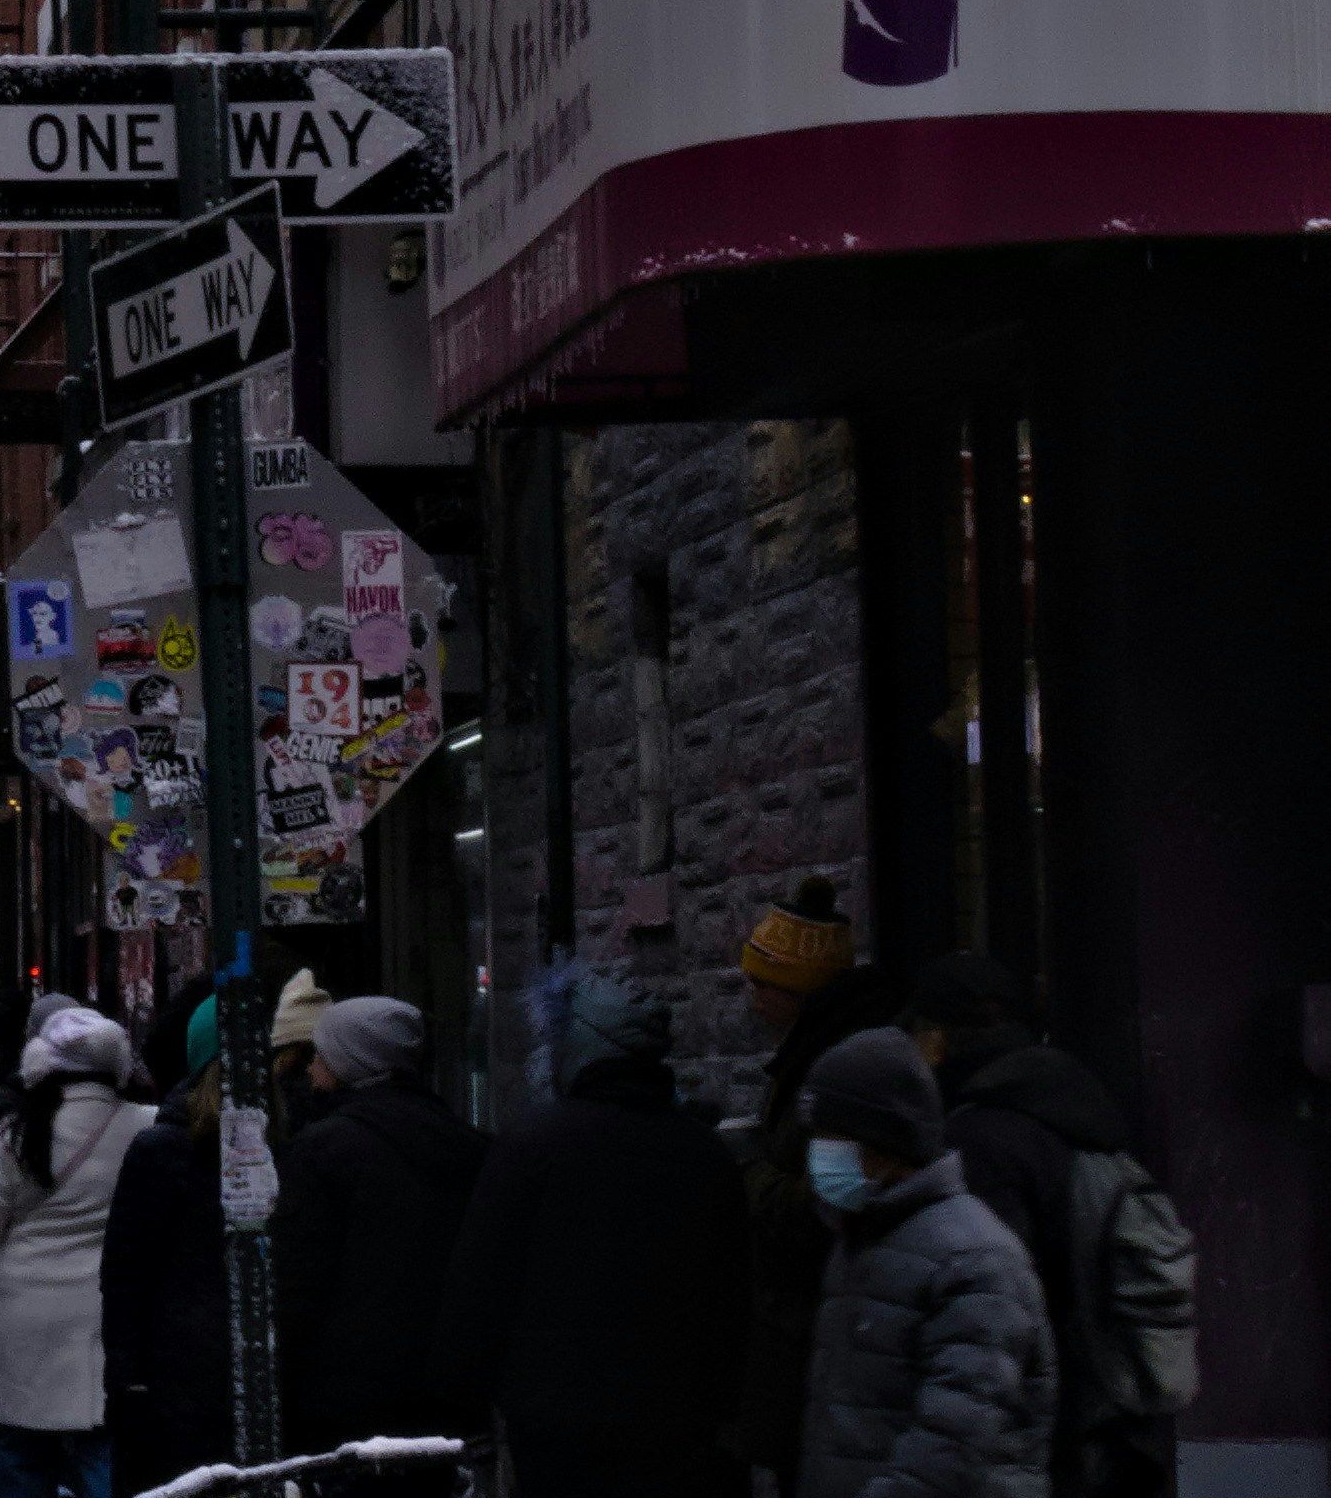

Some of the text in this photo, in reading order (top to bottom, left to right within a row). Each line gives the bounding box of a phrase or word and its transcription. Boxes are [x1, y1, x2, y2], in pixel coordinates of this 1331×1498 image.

[27, 108, 374, 174] ONE WAY
[124, 251, 255, 364] ONE WAY
